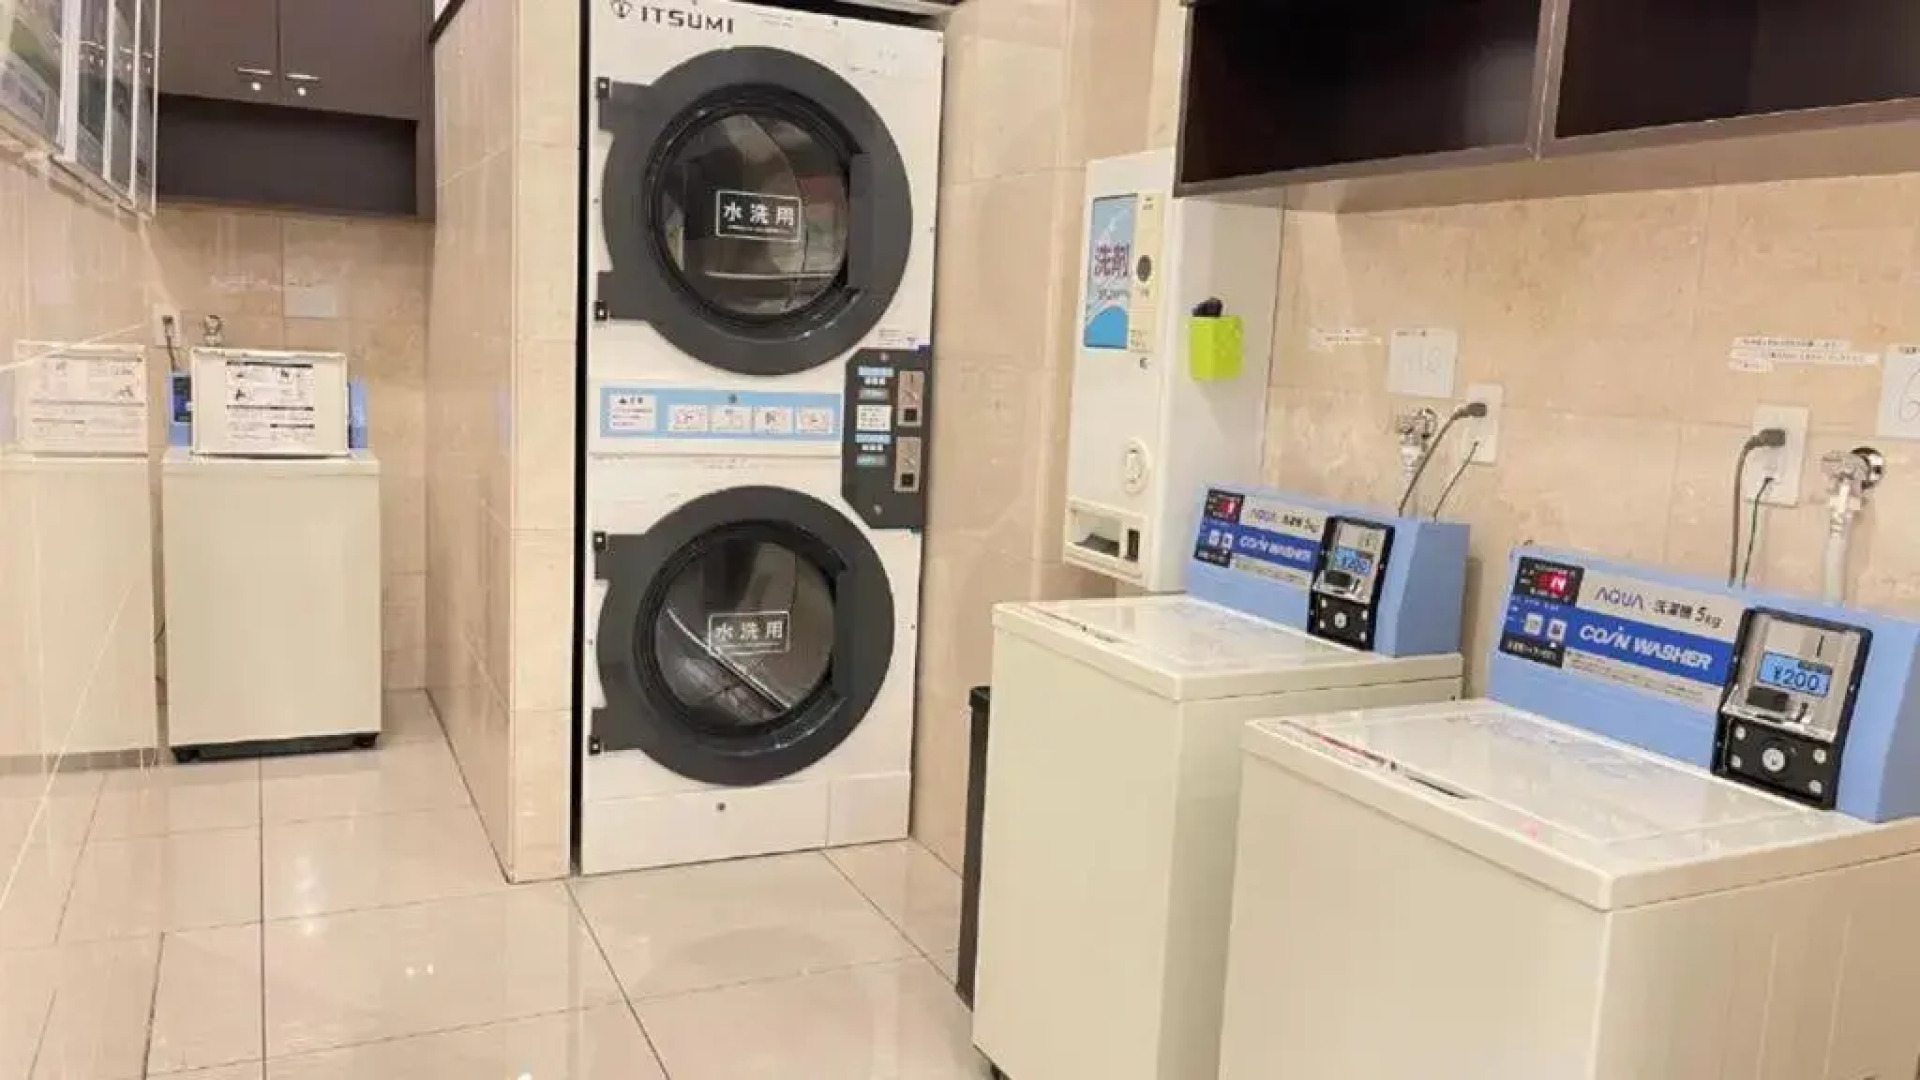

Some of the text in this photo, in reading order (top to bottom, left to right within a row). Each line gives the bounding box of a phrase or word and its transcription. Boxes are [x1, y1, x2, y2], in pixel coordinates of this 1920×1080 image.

[641, 7, 734, 34] ITSUMI
[723, 201, 794, 226] 水洗用
[1594, 586, 1643, 610] AQUA
[714, 621, 783, 641] 水洗用
[1634, 637, 1713, 671] WASHER
[1774, 665, 1820, 691] ¥200
